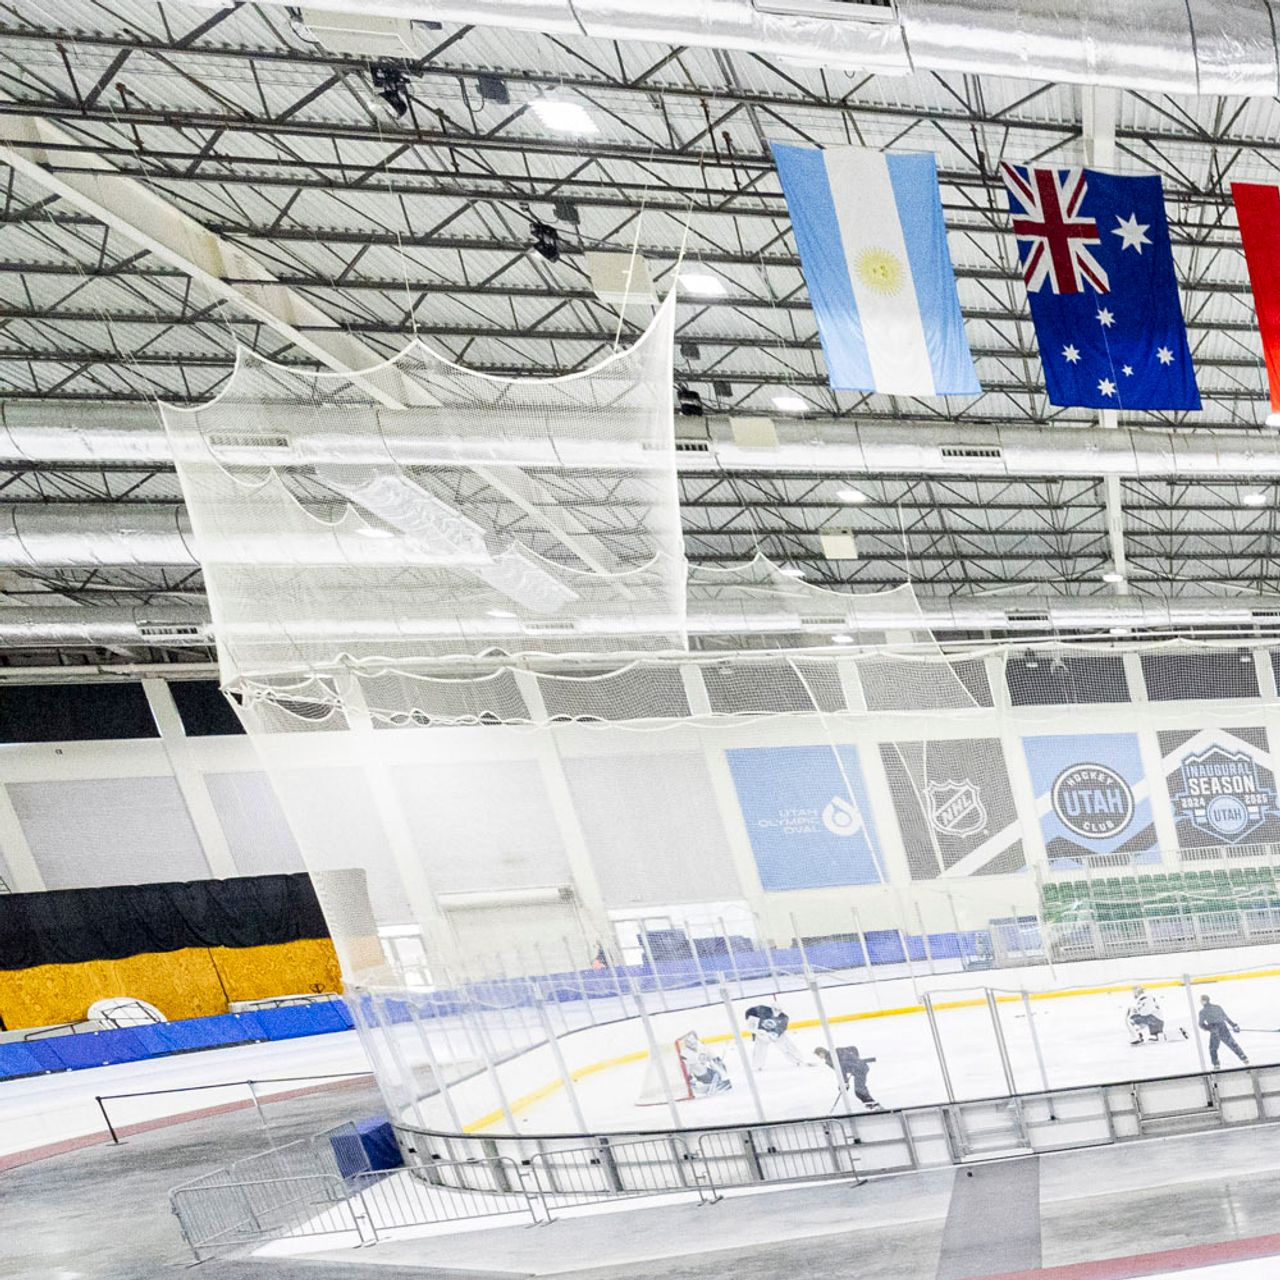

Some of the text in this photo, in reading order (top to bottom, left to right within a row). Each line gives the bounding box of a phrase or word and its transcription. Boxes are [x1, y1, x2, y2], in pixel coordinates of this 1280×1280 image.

[1185, 762, 1253, 778] INAUGURAL
[1066, 770, 1115, 787] HOCKEY
[1188, 775, 1256, 796] SEASON
[941, 794, 972, 825] NHL
[1062, 786, 1124, 817] UTAH
[779, 809, 817, 818] UTAH
[1213, 808, 1241, 822] UTAH
[784, 825, 821, 834] OVAL
[1082, 820, 1115, 832] CLUB
